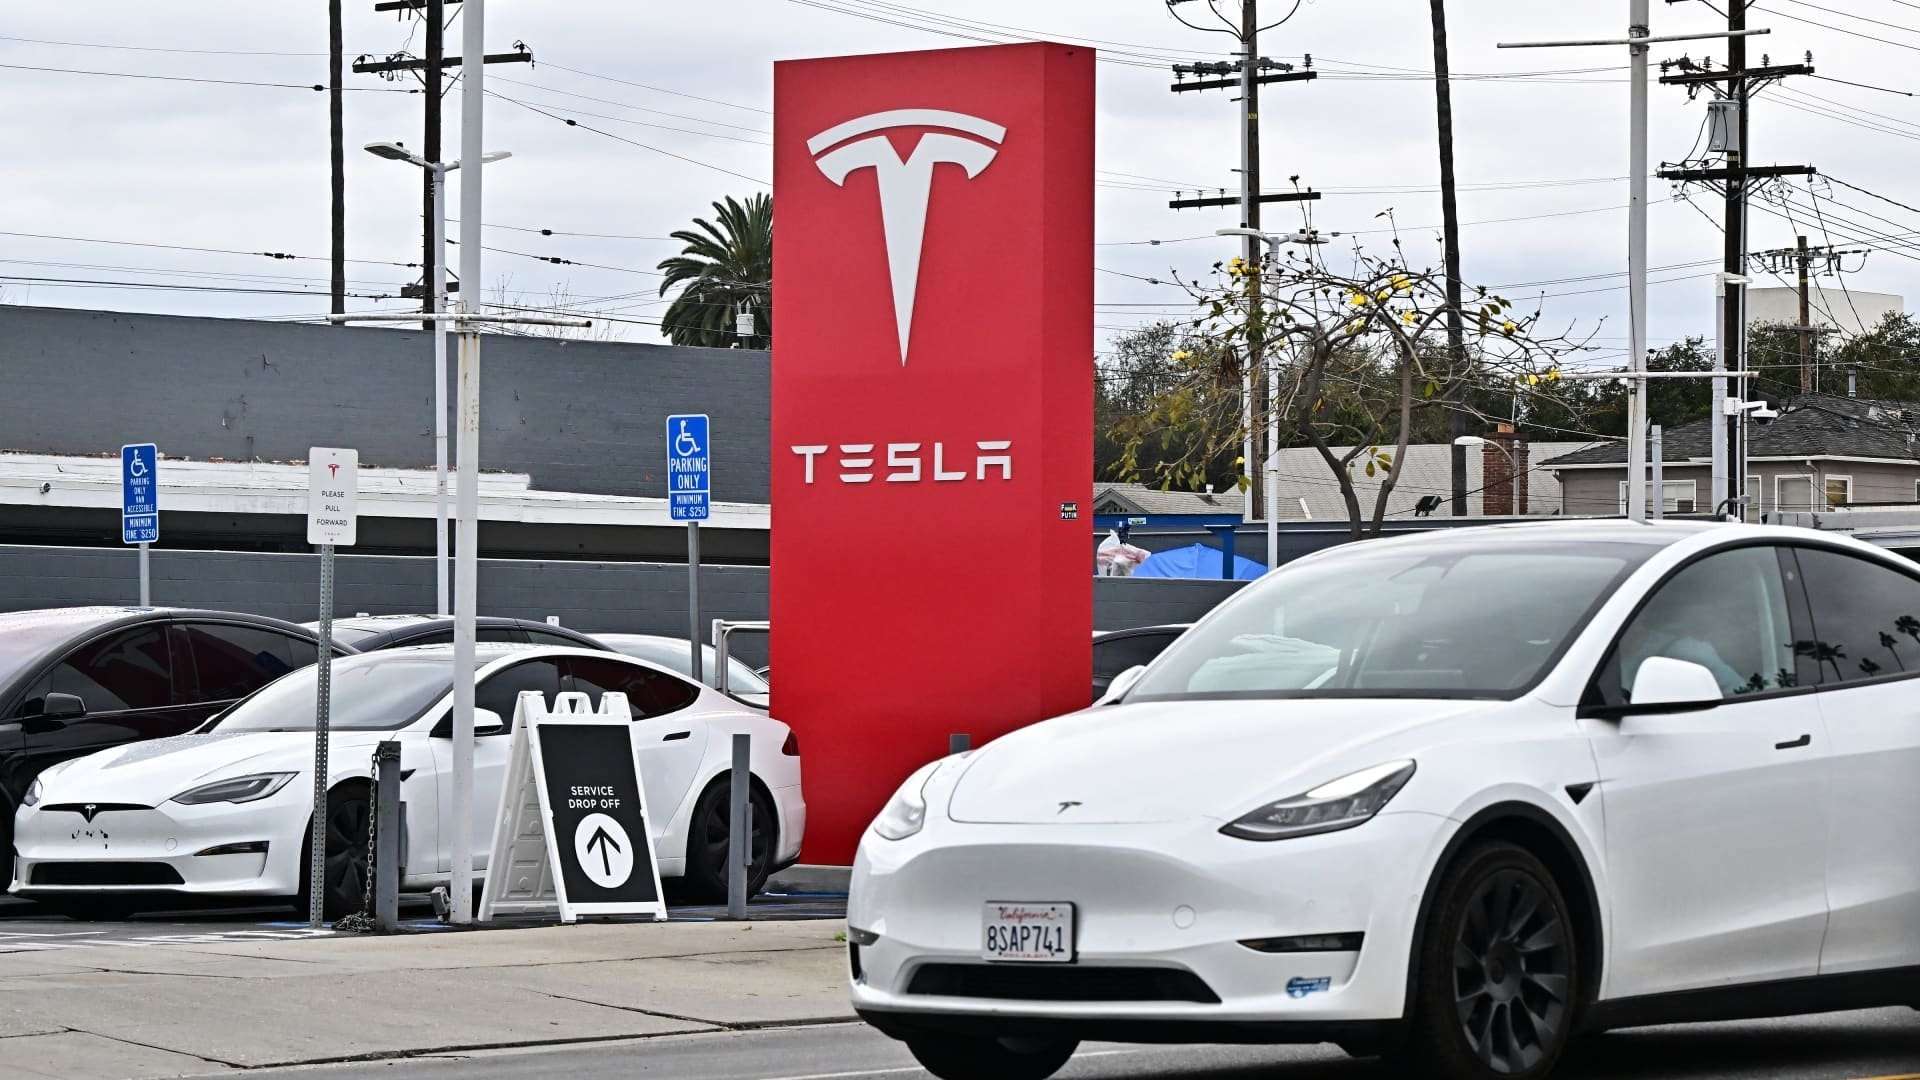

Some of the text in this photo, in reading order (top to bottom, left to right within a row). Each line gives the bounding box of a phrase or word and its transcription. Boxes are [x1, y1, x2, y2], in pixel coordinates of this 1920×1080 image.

[671, 458, 706, 472] PARKING
[791, 440, 1013, 484] TESLA
[677, 474, 700, 489] ONLY
[133, 487, 146, 495] ONLY
[321, 490, 345, 498] PLEASE
[676, 494, 703, 505] MINIMUM
[127, 503, 154, 513] ACCESSIBLE
[673, 506, 706, 518] FINE $250
[129, 517, 152, 528] MINIMUM
[316, 518, 348, 527] FORWARD
[126, 528, 156, 540] FINE $250
[571, 786, 614, 796] SERVICE
[568, 799, 621, 809] DROP OFF
[987, 925, 1065, 953] 8SAP741
